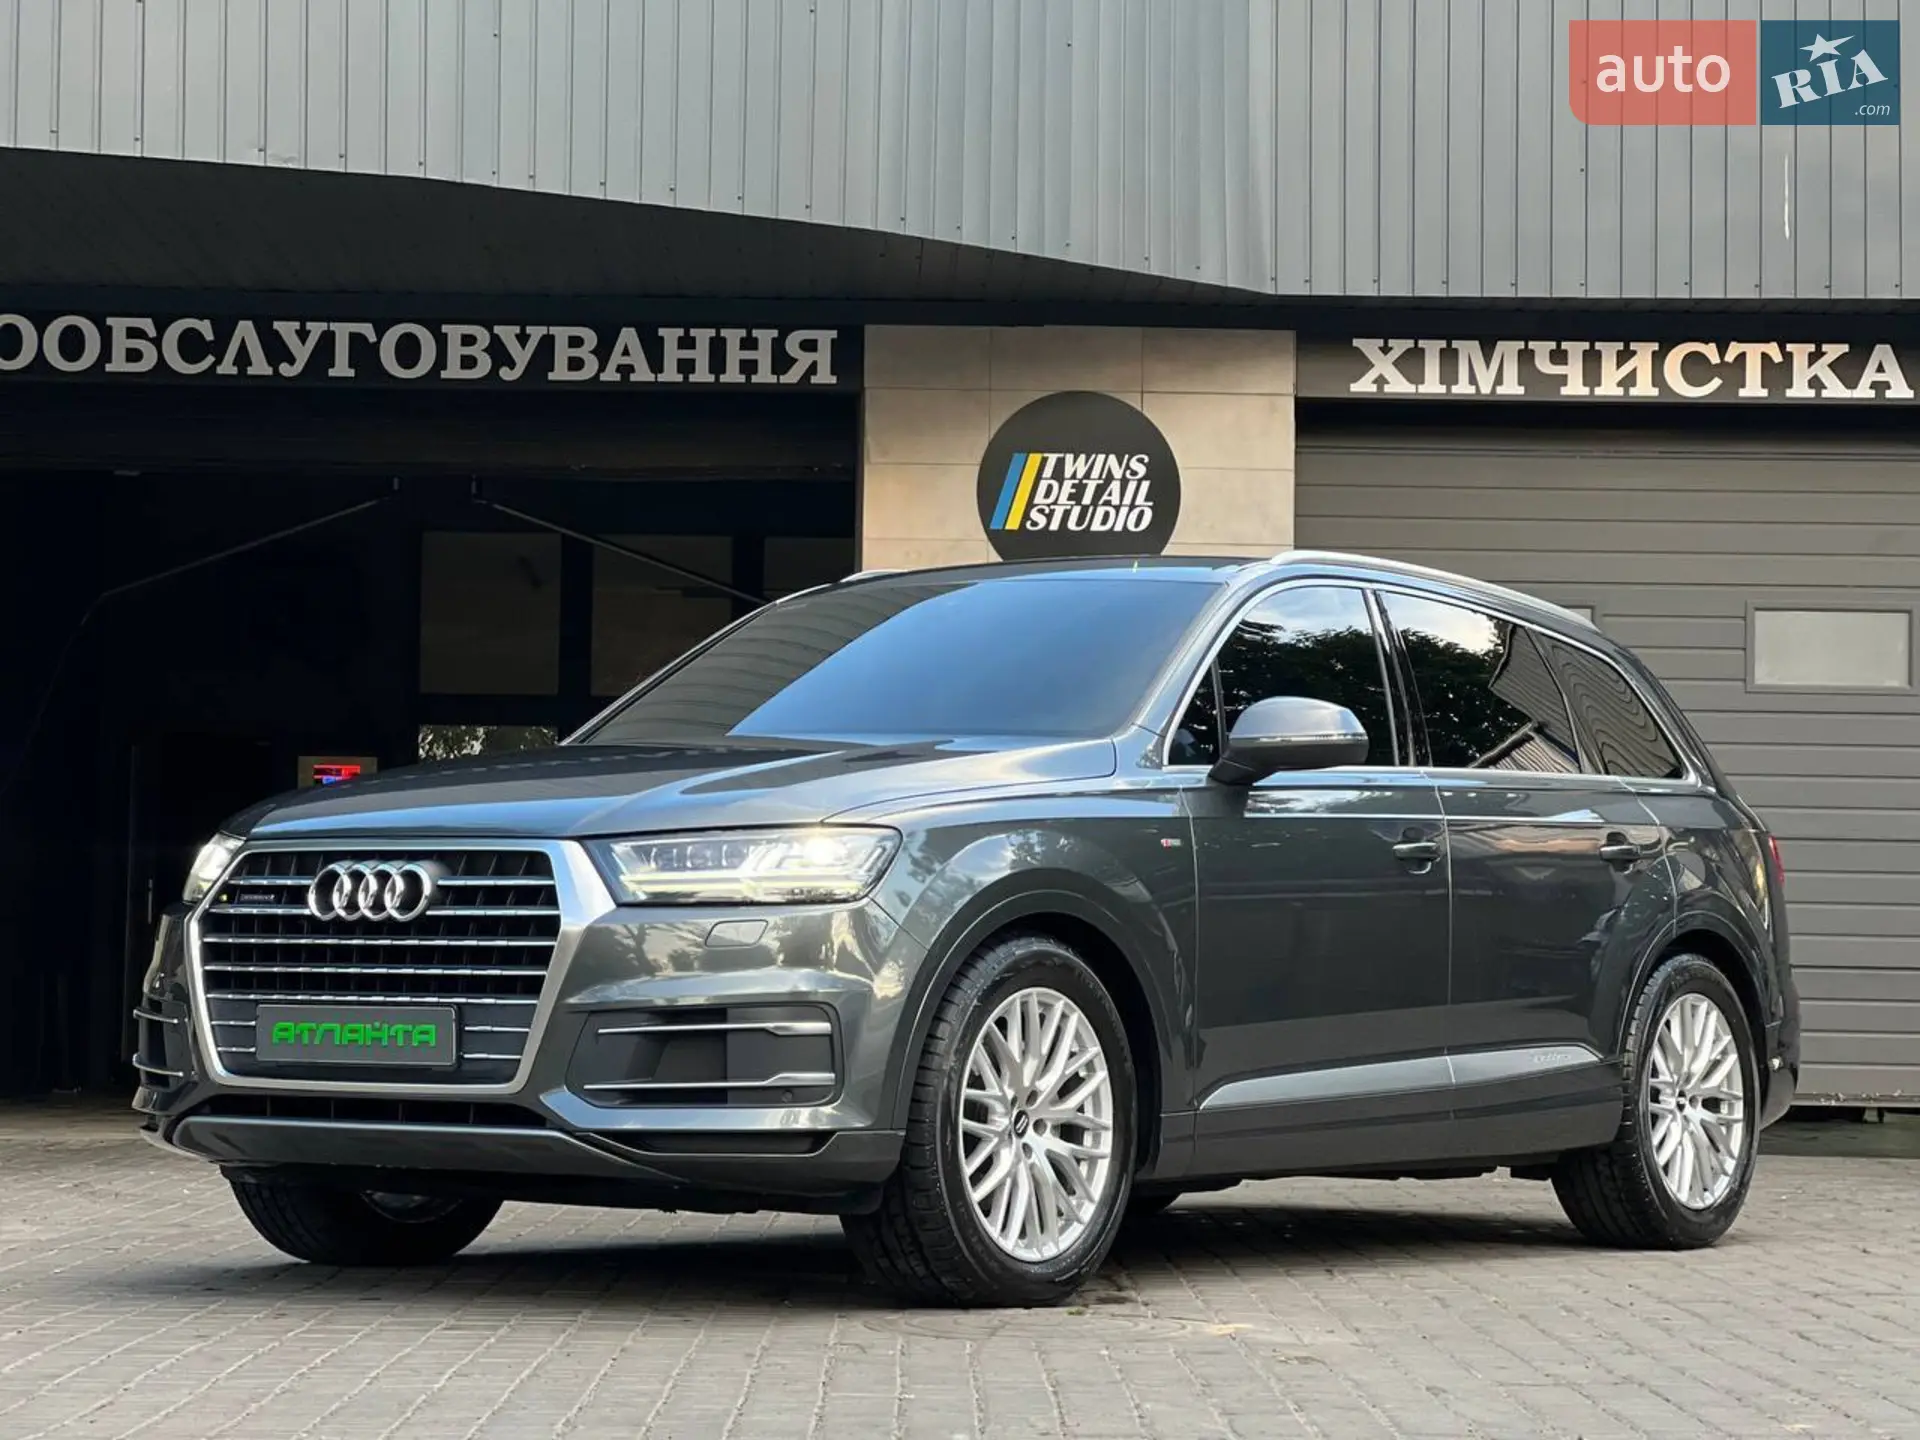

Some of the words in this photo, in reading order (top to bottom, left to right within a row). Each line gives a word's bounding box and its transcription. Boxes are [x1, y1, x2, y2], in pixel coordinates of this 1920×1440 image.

[0, 313, 838, 384] ООБСЛУГОВУВАННЯ
[1350, 338, 1914, 399] ХІМЧИСТКА
[1041, 453, 1149, 480] TWINS
[1032, 480, 1153, 506] DETAIL
[1025, 505, 1153, 532] STUDIO
